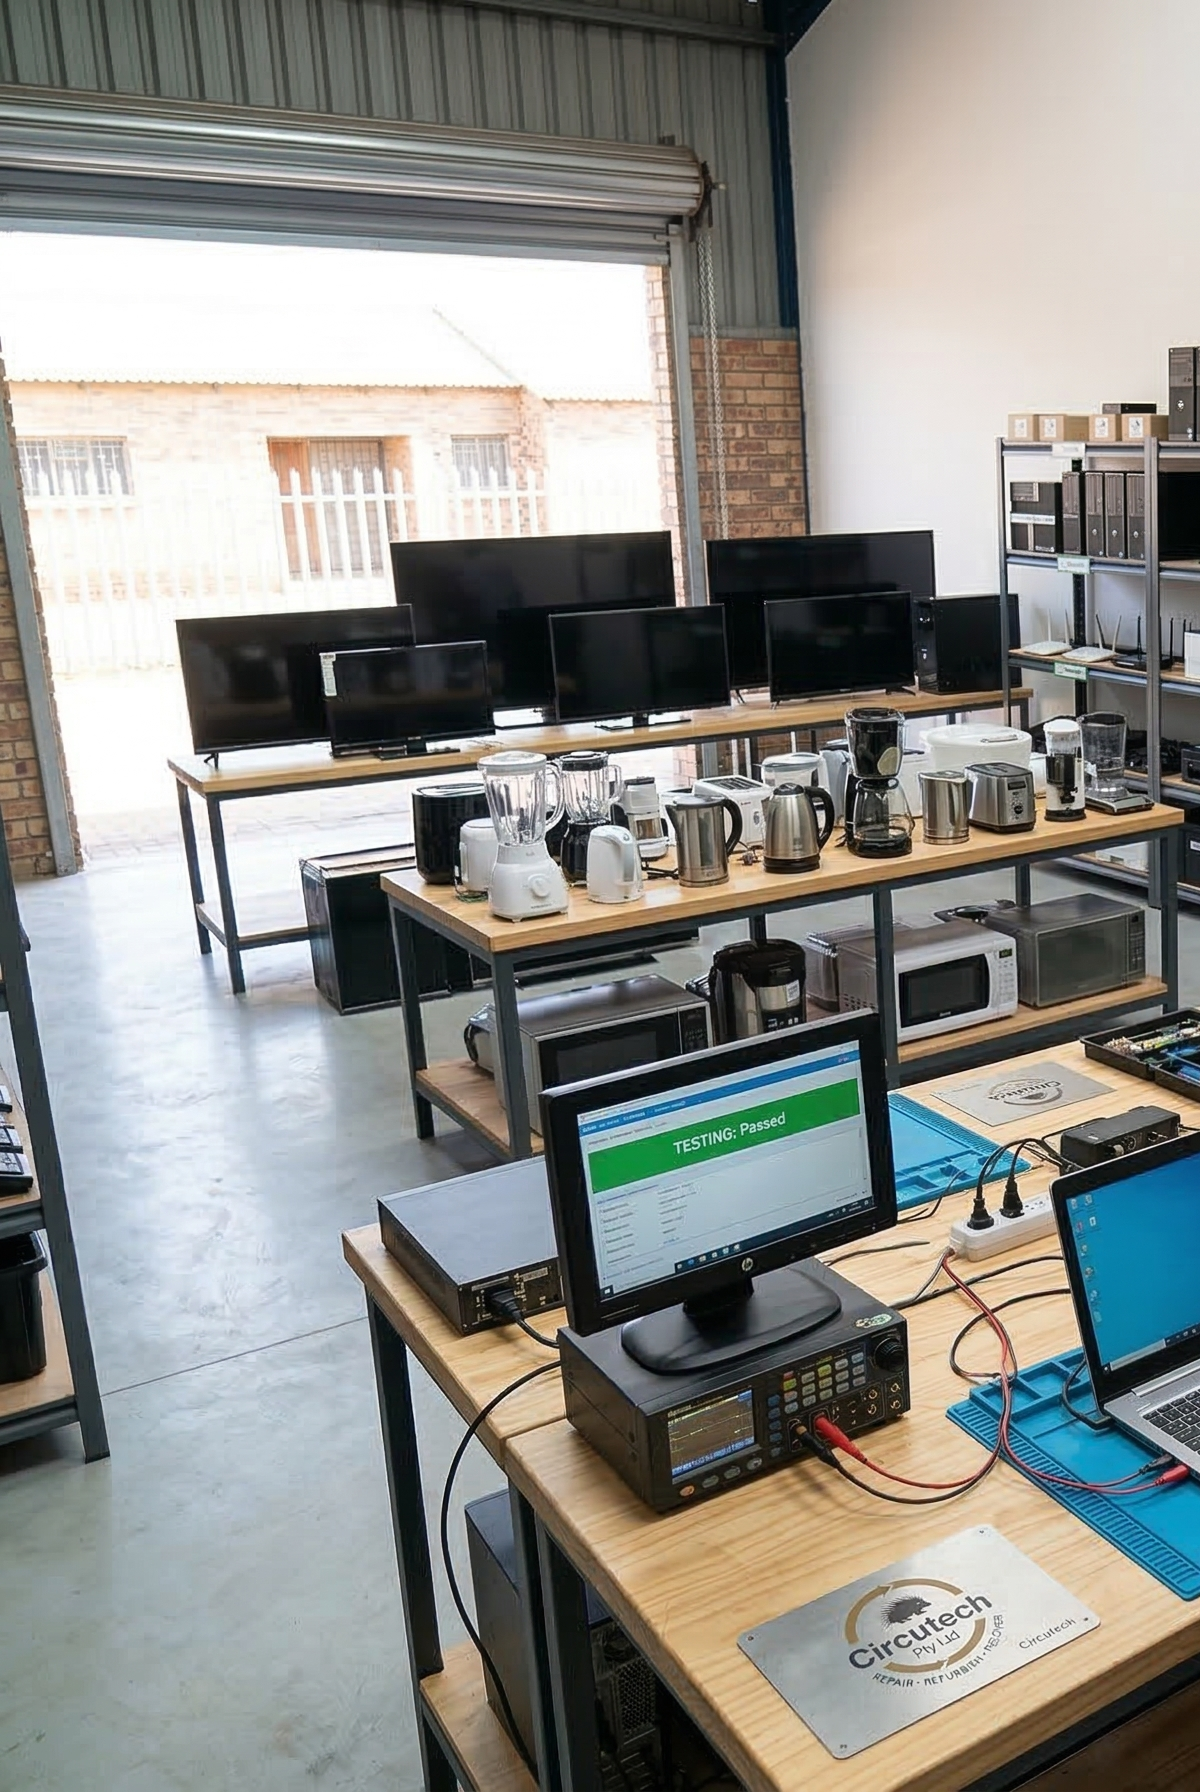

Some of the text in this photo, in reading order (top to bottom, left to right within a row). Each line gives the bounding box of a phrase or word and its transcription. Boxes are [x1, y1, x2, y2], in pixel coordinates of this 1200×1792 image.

[673, 1127, 737, 1155] TESTING:
[740, 1111, 786, 1136] Passed
[849, 1595, 993, 1669] Circutech
